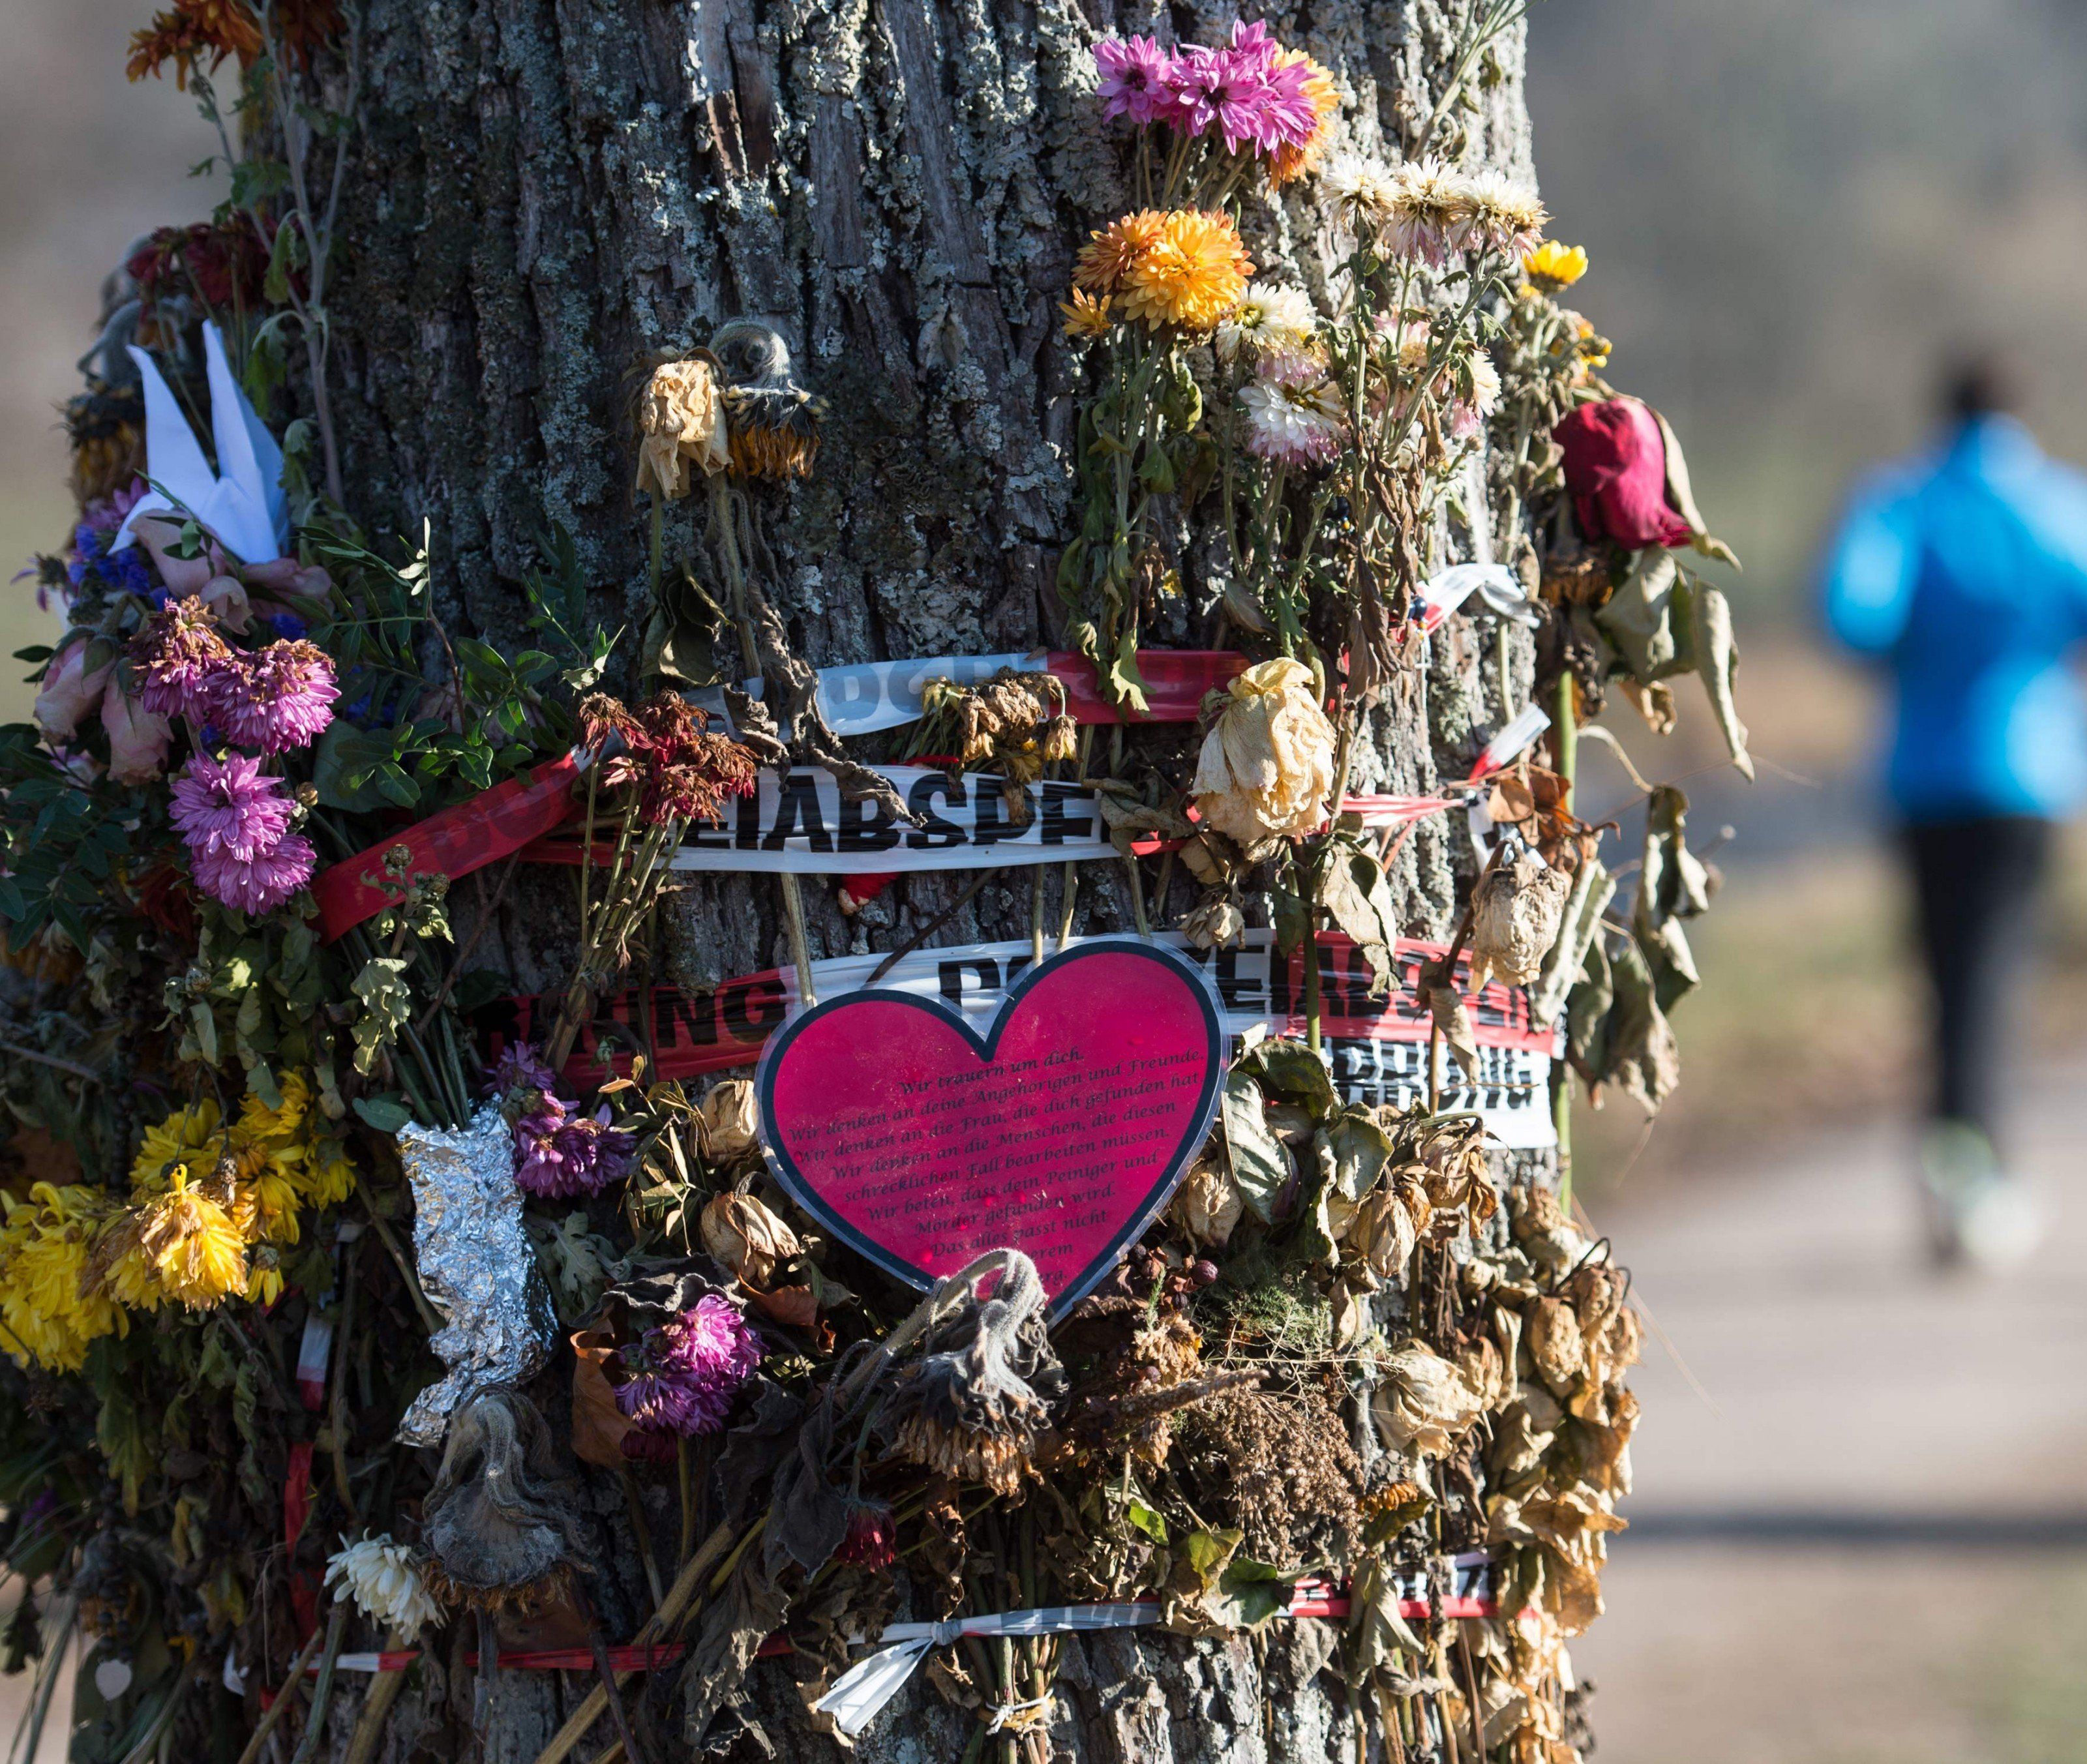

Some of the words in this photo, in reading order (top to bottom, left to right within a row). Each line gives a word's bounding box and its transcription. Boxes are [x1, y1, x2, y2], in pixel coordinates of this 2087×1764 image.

[788, 1126, 820, 1143] Wir
[826, 1111, 887, 1135] denken
[892, 1108, 914, 1120] an
[920, 1096, 965, 1116] deine
[1088, 1062, 1122, 1083] und
[1127, 1047, 1204, 1077] Freunde.
[898, 1078, 933, 1096] Wir
[938, 1065, 1005, 1090] trauern
[1011, 1059, 1039, 1073] um
[1044, 1046, 1084, 1067] dich.
[794, 1147, 830, 1163] Wir
[834, 1133, 897, 1157] denken
[901, 1129, 923, 1142] an
[928, 1121, 953, 1137] die
[959, 1113, 1007, 1135] Frau,
[1012, 1104, 1039, 1120] die
[1044, 1094, 1081, 1114] dich
[1085, 1078, 1166, 1111] gefunden
[831, 1165, 863, 1180] Wir
[869, 1151, 932, 1174] denken
[937, 1146, 959, 1160] an
[963, 1137, 989, 1154] die
[995, 1120, 1086, 1148] Menschen,
[1091, 1112, 1117, 1129] die
[1122, 1100, 1176, 1122] diesen
[843, 1169, 960, 1203] schrecklichen
[966, 1156, 1001, 1180] Fall
[1005, 1139, 1096, 1169] bearbeiten
[1101, 1127, 1169, 1149] müssen.
[865, 1206, 897, 1221] Wir
[905, 1193, 955, 1215] beten,
[961, 1184, 997, 1203] dass
[1002, 1176, 1042, 1194] dein
[1046, 1161, 1118, 1185] Peiniger
[1124, 1148, 1160, 1169] und
[930, 1240, 965, 1257] Das
[969, 1230, 1008, 1249] alles
[1013, 1220, 1057, 1245] passt
[1063, 1208, 1107, 1231] nicht
[985, 1195, 1065, 1226] gefunden
[1071, 1181, 1115, 1204] wird.
